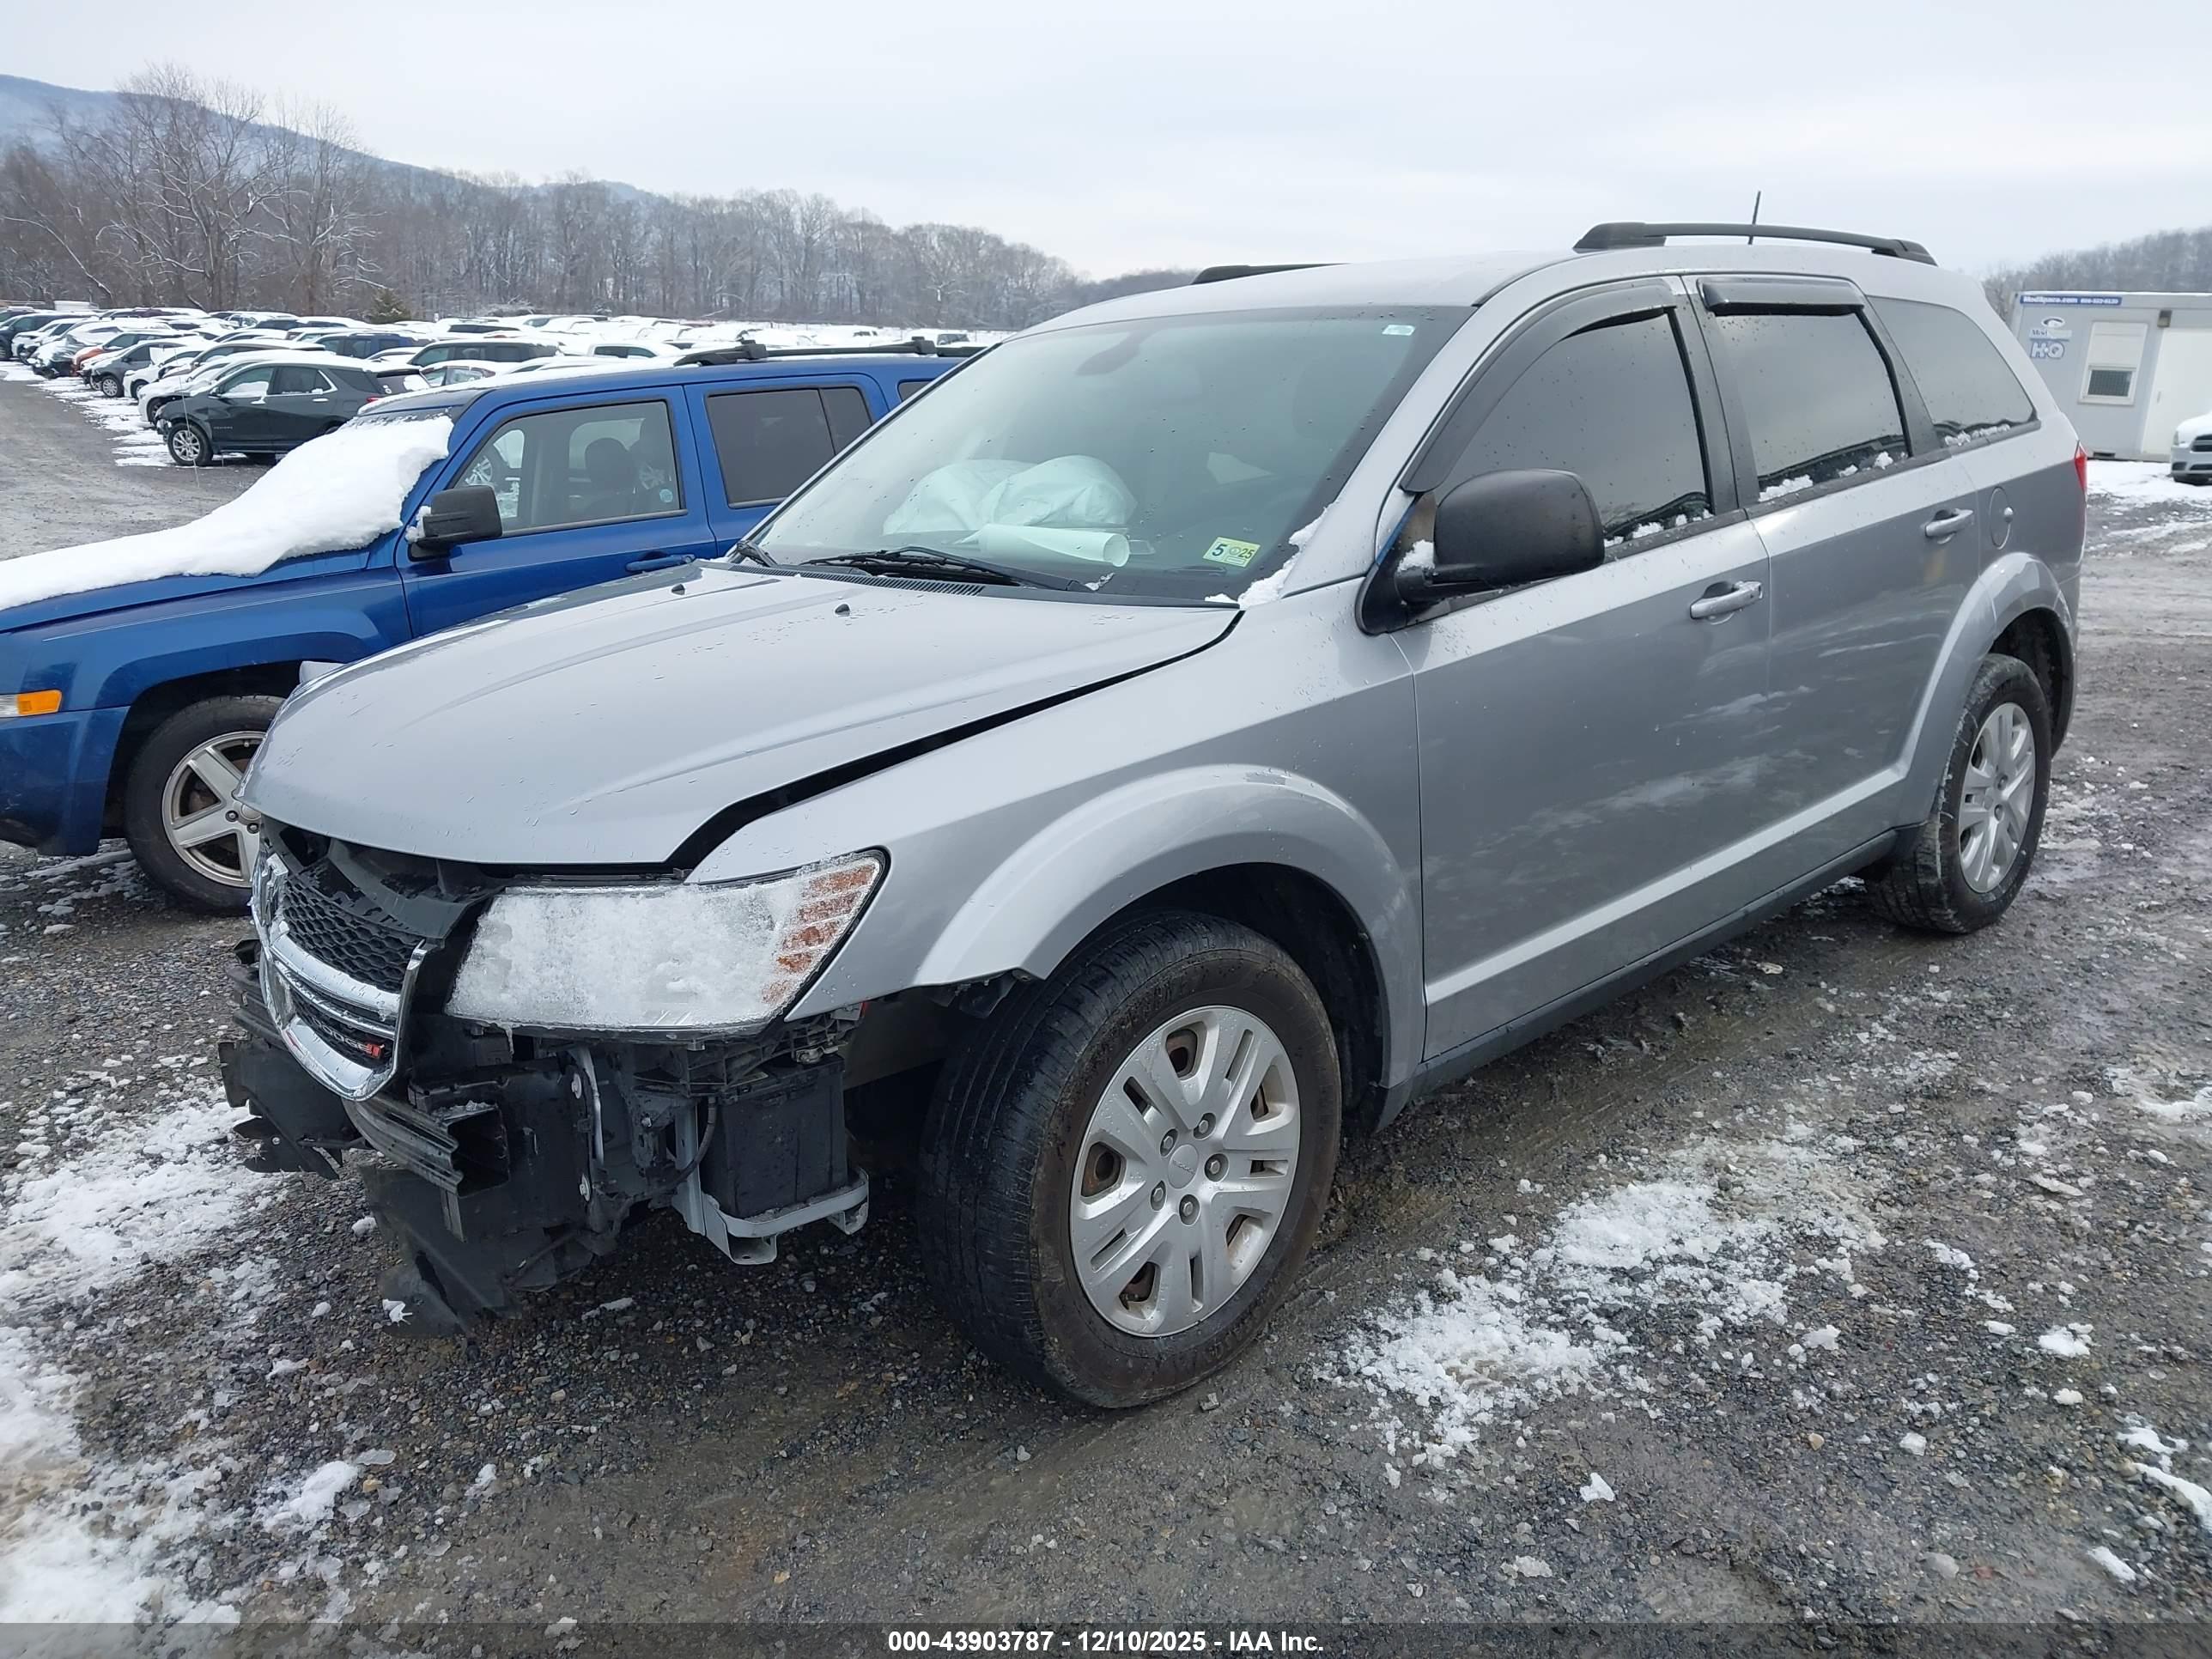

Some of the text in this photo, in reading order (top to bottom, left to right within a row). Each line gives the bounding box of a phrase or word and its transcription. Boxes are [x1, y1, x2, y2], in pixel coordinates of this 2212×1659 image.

[1212, 543, 1255, 559] 5 25
[311, 1015, 373, 1054] DODGE
